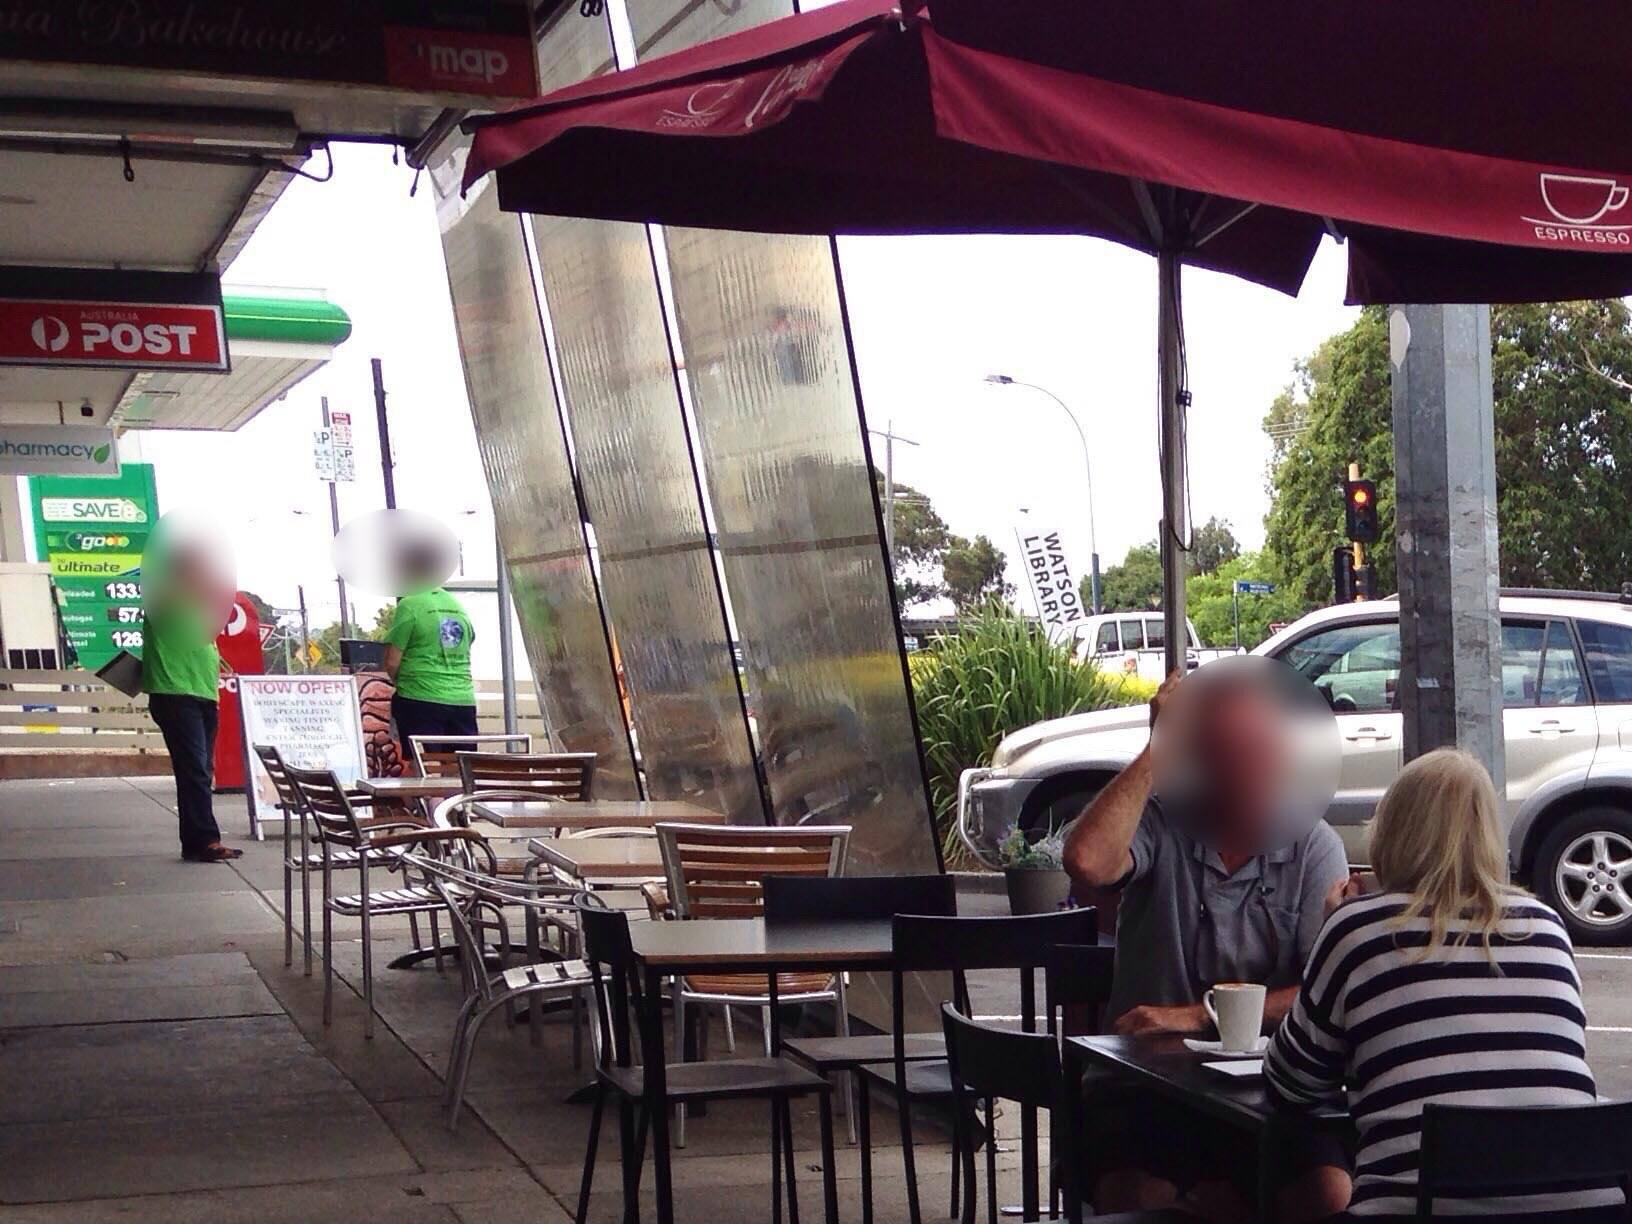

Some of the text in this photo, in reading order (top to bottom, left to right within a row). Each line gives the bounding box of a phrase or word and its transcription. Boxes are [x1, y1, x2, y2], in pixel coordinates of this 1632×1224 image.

[429, 44, 509, 84] map
[1534, 225, 1631, 245] ESPRESSO
[80, 310, 140, 322] AUSTRALIA
[81, 323, 198, 355] POST
[73, 502, 121, 518] SAVE
[57, 561, 121, 573] ultimate
[1043, 531, 1081, 622] WATSON
[1023, 535, 1063, 626] LIBRARY
[250, 681, 346, 695] NOW OPEN
